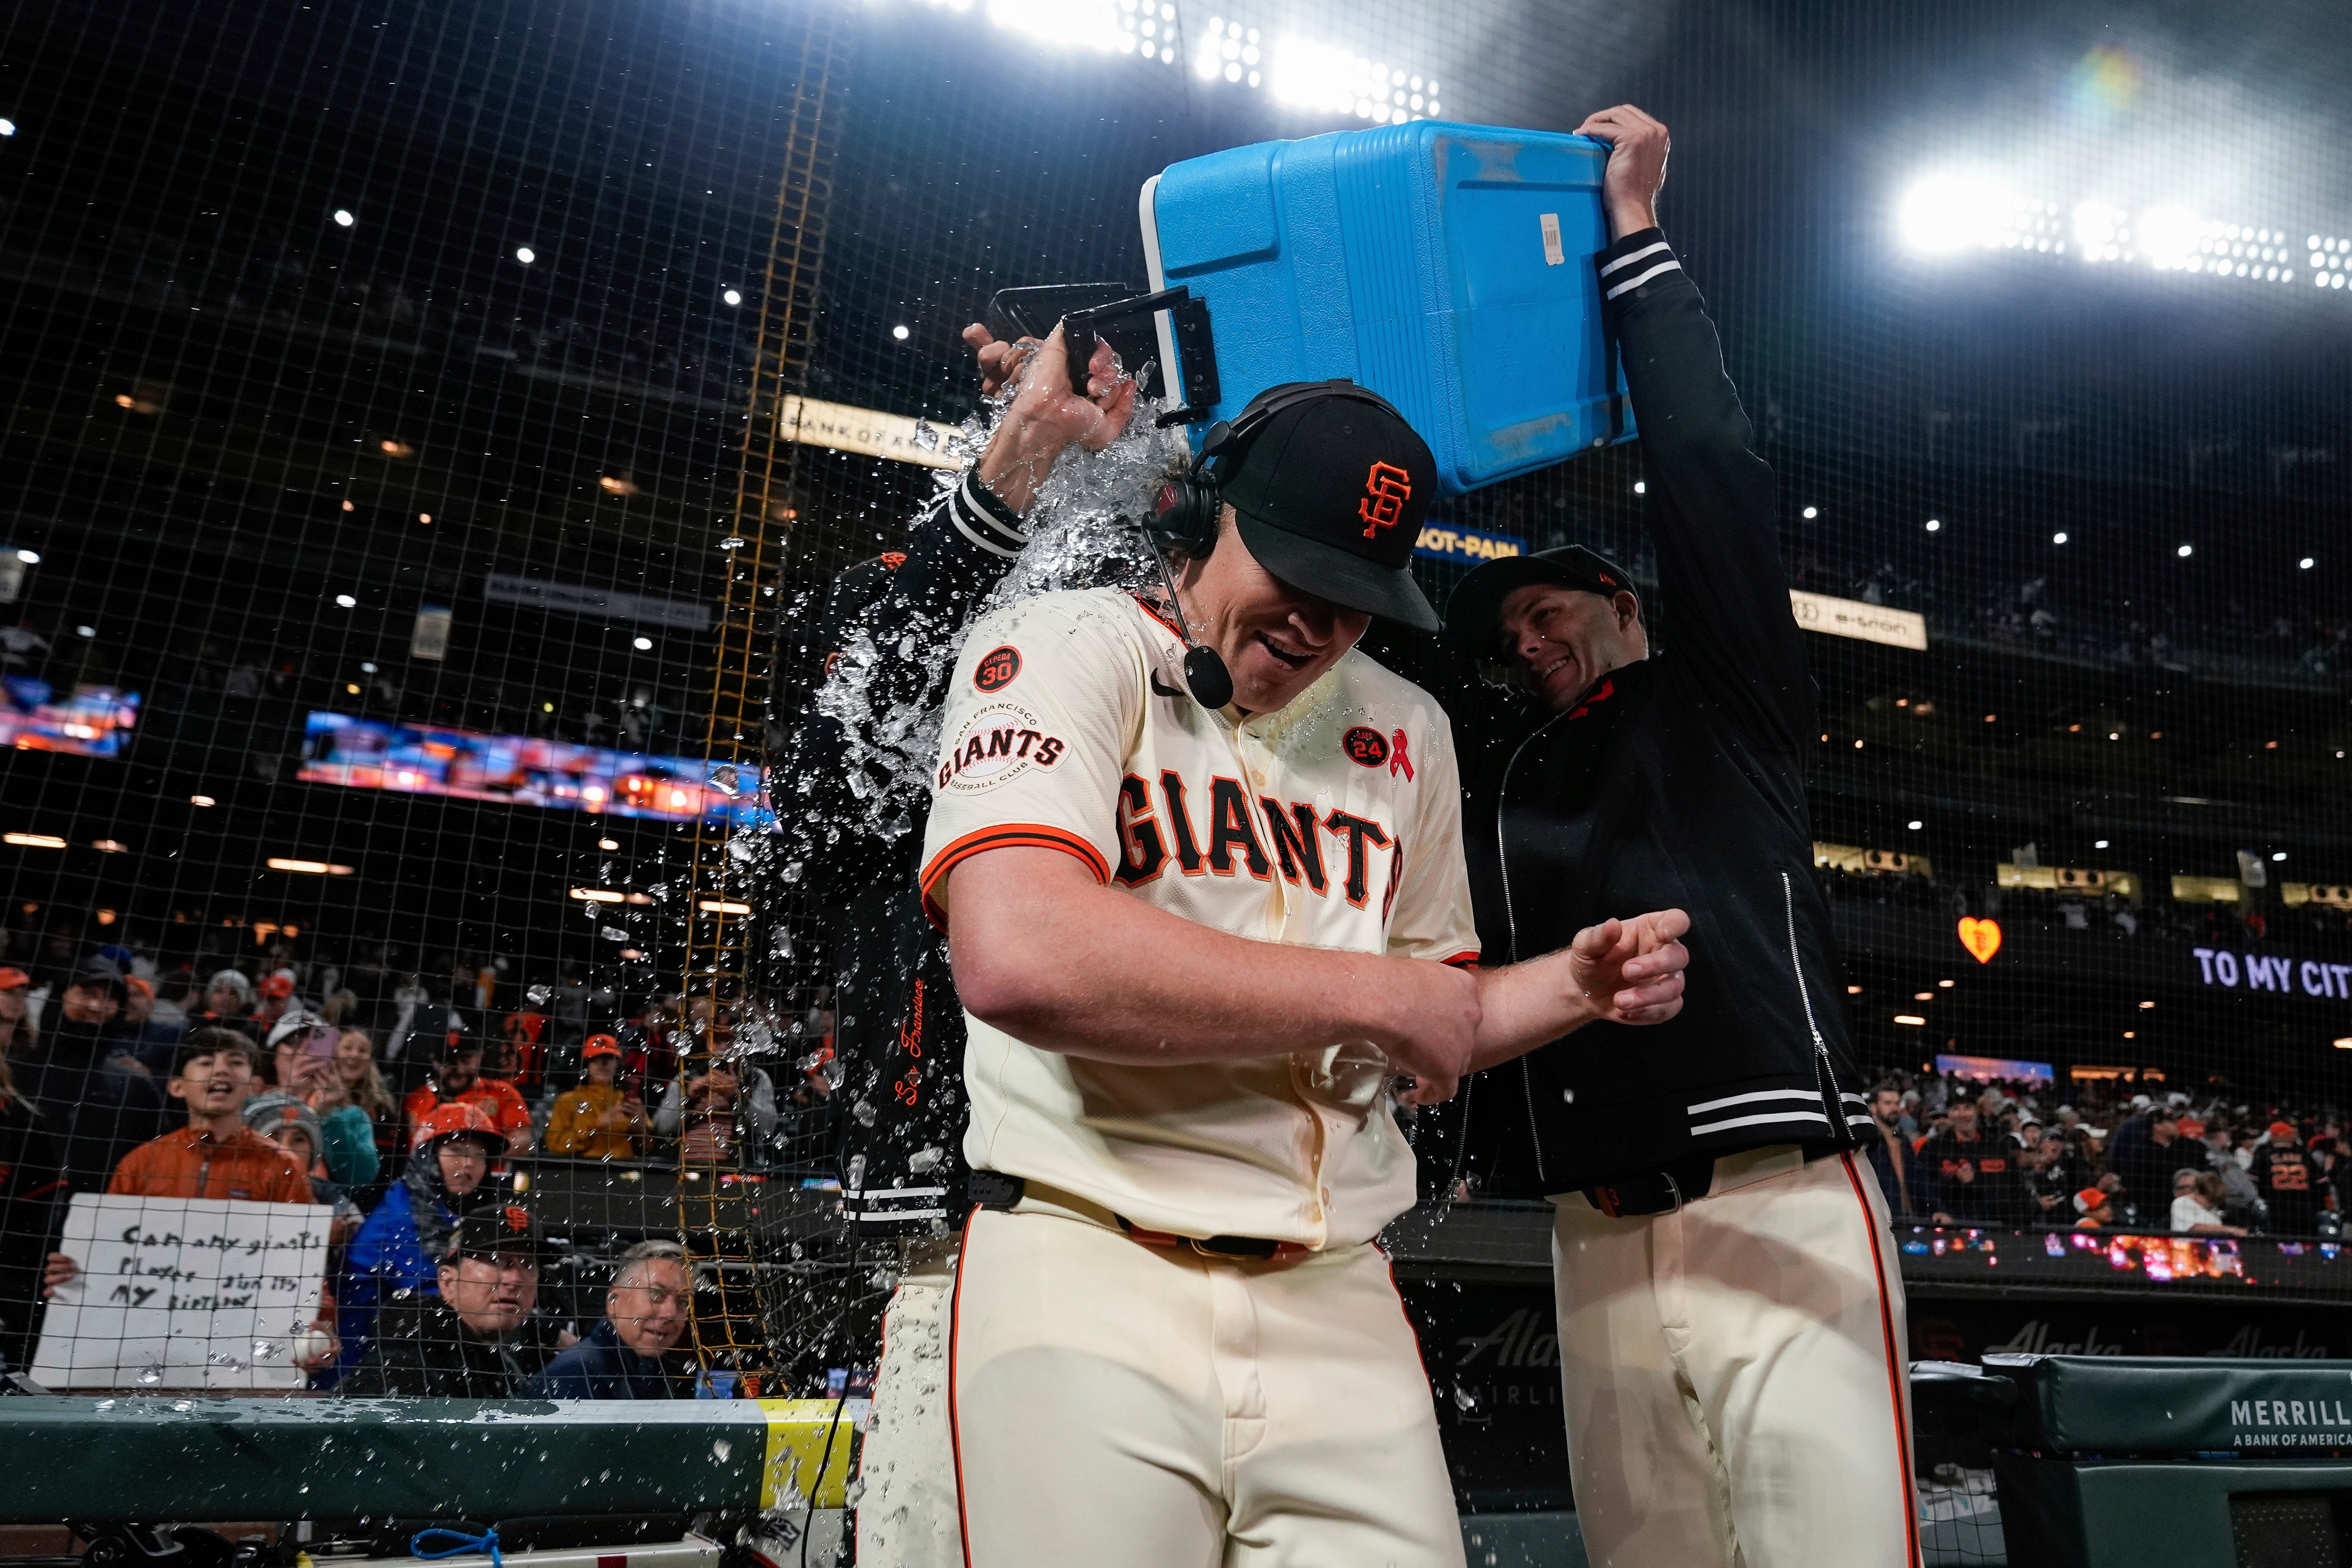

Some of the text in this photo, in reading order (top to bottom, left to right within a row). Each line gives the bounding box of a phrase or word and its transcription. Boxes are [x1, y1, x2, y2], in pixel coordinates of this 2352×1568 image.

[1358, 461, 1411, 539] SF
[982, 662, 1012, 685] 30
[984, 653, 1011, 667] CEPEDA
[955, 703, 1037, 745] SAN FRANCISCO
[939, 728, 1065, 790] GIANTS
[1353, 741, 1383, 758] 24
[949, 762, 1029, 791] BASEBALL CLUB
[2193, 947, 2352, 1000] TO MY CIT
[901, 977, 923, 1058] Francisco
[2270, 1164, 2309, 1191] 22
[122, 1224, 182, 1247] Can
[2231, 1400, 2351, 1426] MERRILL
[2233, 1434, 2242, 1446] A
[2245, 1434, 2279, 1446] BANK
[2281, 1434, 2297, 1446] OF
